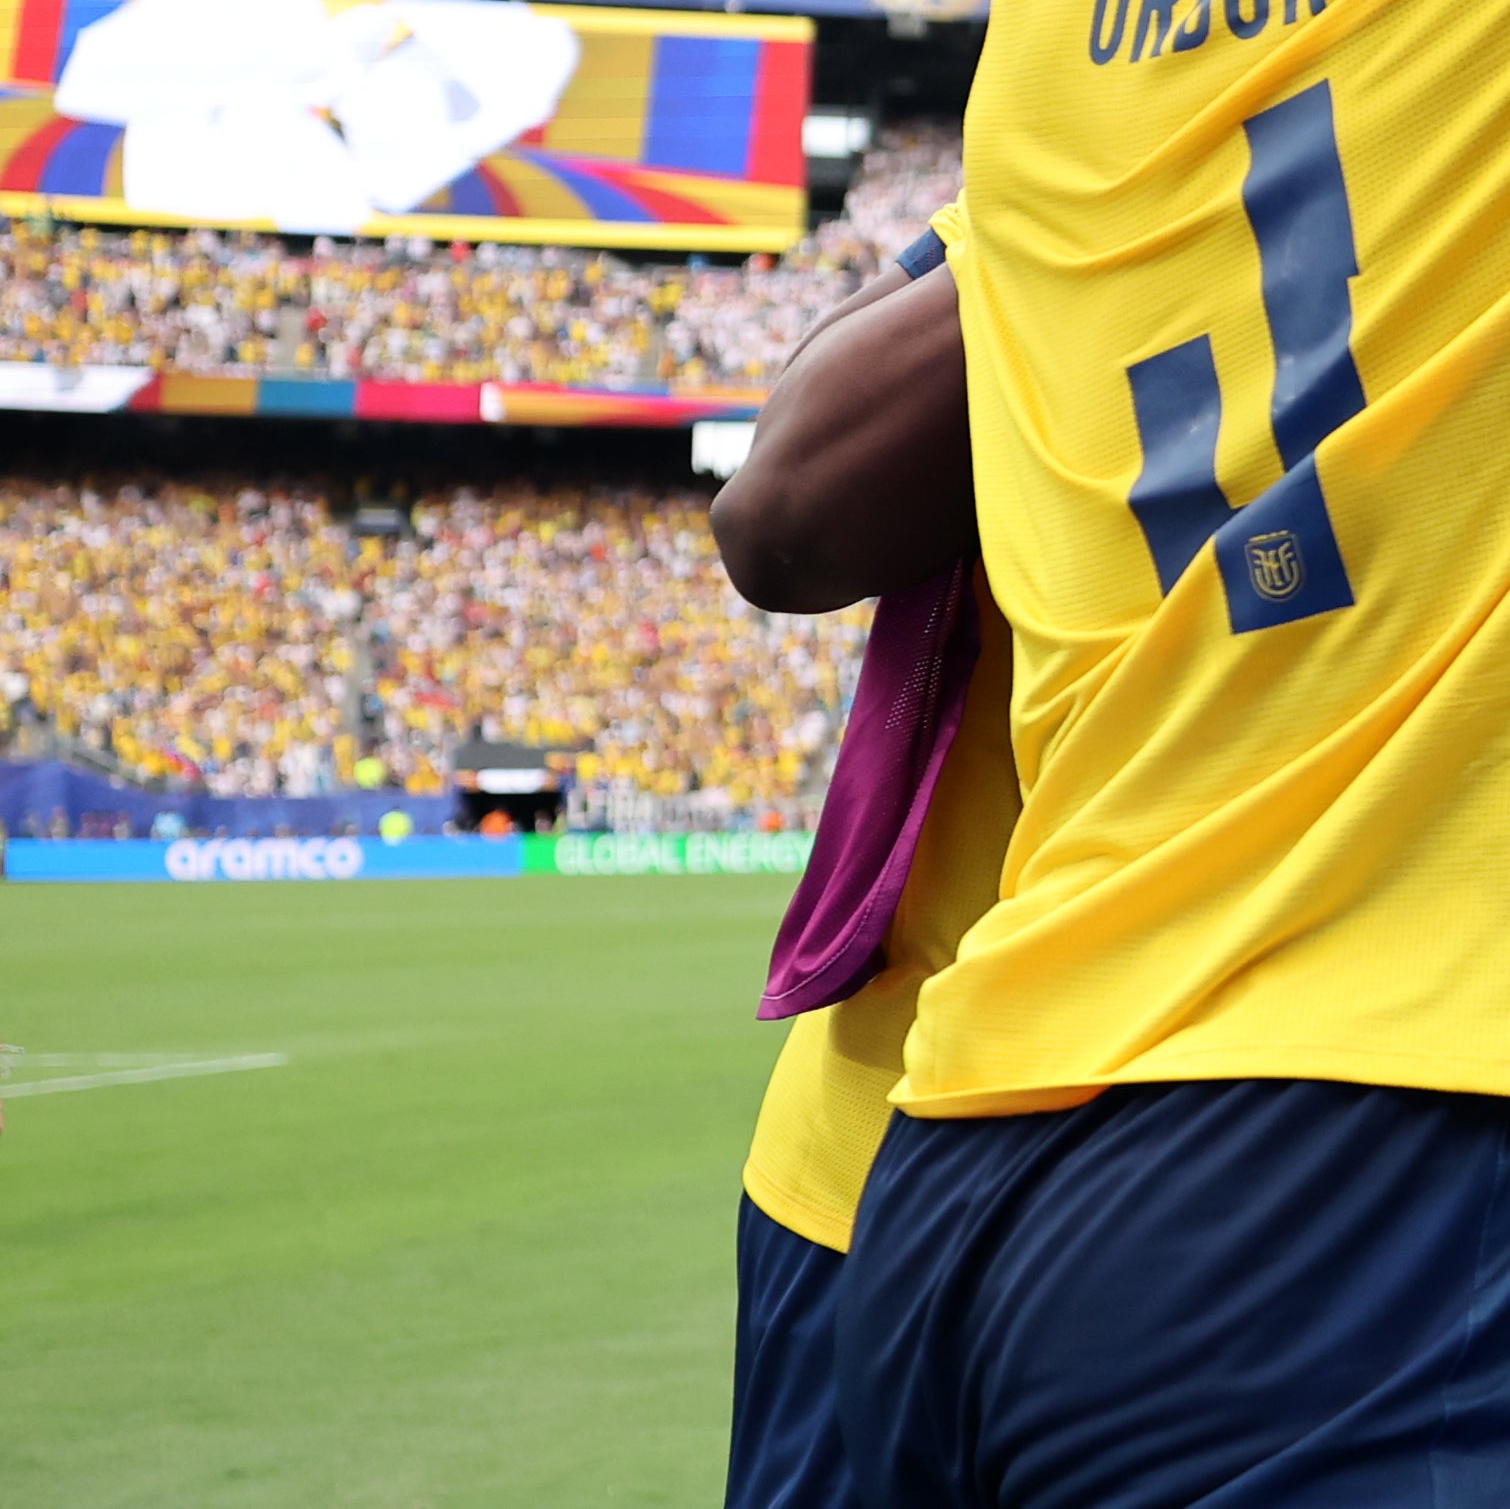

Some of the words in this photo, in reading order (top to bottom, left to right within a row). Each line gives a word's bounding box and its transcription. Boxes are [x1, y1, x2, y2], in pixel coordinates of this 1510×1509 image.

[1126, 78, 1367, 635] 4
[165, 837, 364, 882] aramco
[554, 832, 682, 875] GLOBAL
